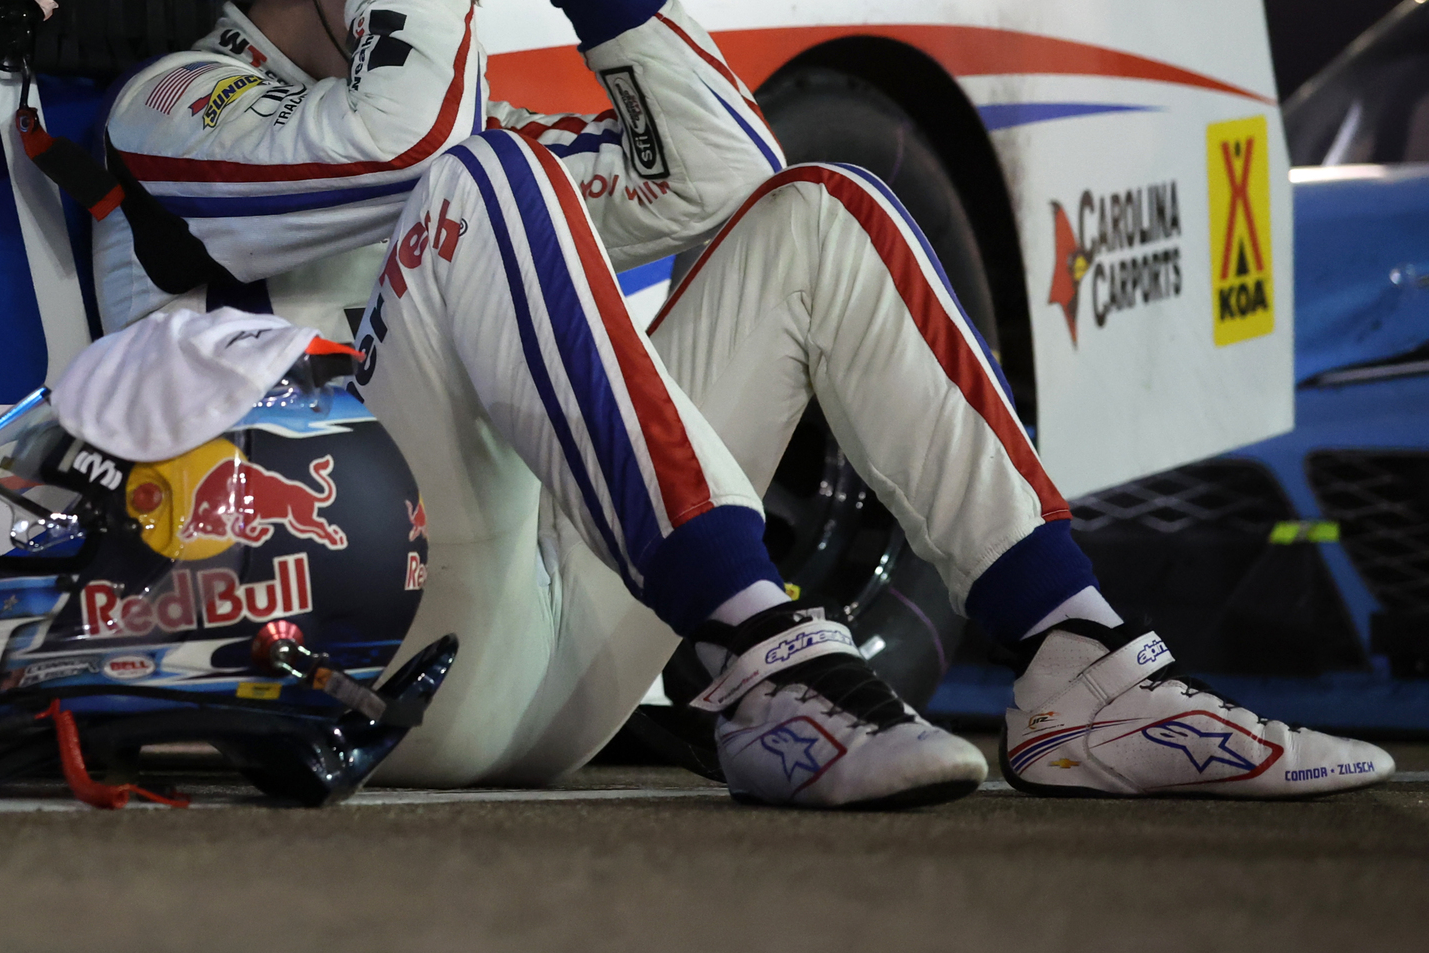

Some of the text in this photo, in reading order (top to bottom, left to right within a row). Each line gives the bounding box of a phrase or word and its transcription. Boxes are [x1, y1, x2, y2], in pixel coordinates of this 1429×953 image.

[205, 74, 262, 124] SUNOC
[634, 134, 653, 162] sfi
[1079, 179, 1182, 254] CAROLINA
[1092, 246, 1183, 329] CARPORTS
[1219, 278, 1269, 323] KOA
[81, 552, 313, 640] Red Bull
[109, 660, 148, 672] BELL
[1285, 761, 1375, 781] CONNOR ZILISCH
